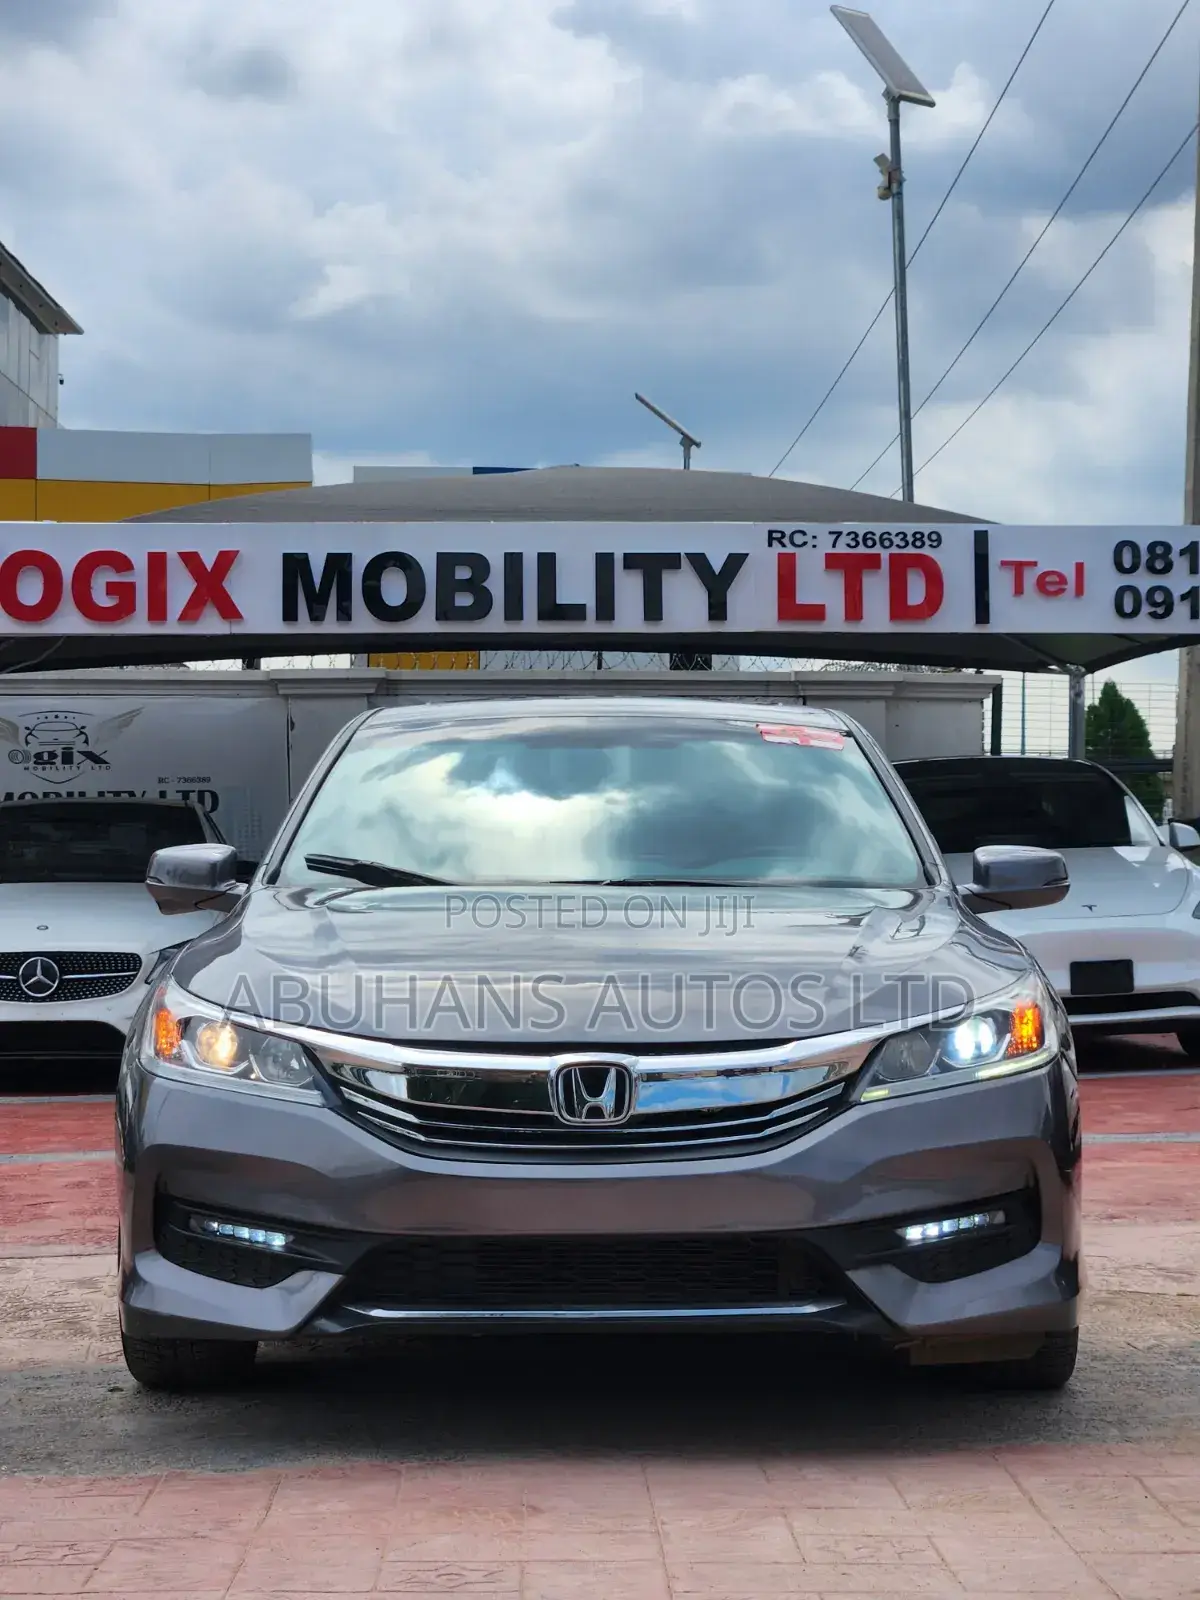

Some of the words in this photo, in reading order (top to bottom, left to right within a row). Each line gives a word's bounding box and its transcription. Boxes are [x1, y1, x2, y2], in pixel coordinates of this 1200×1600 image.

[767, 530, 818, 549] RC:
[828, 530, 943, 549] 7366389
[1113, 539, 1200, 575] 081
[0, 549, 244, 622] OGIX
[282, 551, 750, 622] MOBILITY
[777, 552, 945, 622] LTD
[1000, 560, 1085, 598] Tel
[1114, 585, 1200, 620] 091
